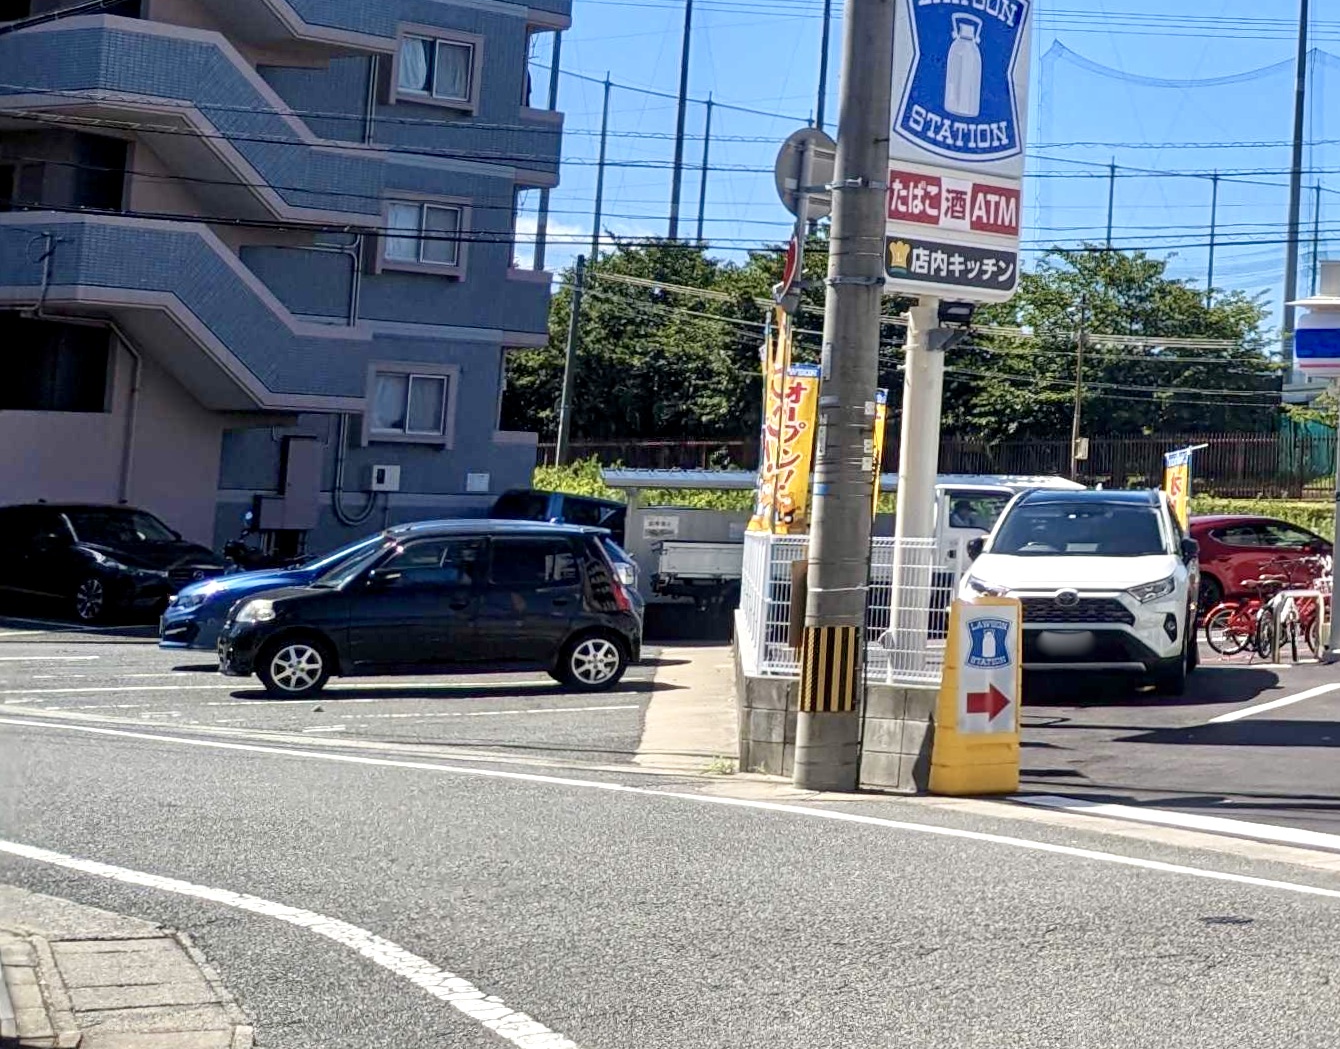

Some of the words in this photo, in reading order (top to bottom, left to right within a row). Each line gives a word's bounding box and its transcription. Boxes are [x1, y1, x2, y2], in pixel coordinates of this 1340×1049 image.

[909, 104, 1009, 148] STATION
[891, 178, 939, 216] たばこ
[944, 188, 968, 220] 酒
[971, 192, 1017, 227] ATM
[910, 247, 1013, 282] 店内キッチン
[778, 381, 807, 491] オープン!
